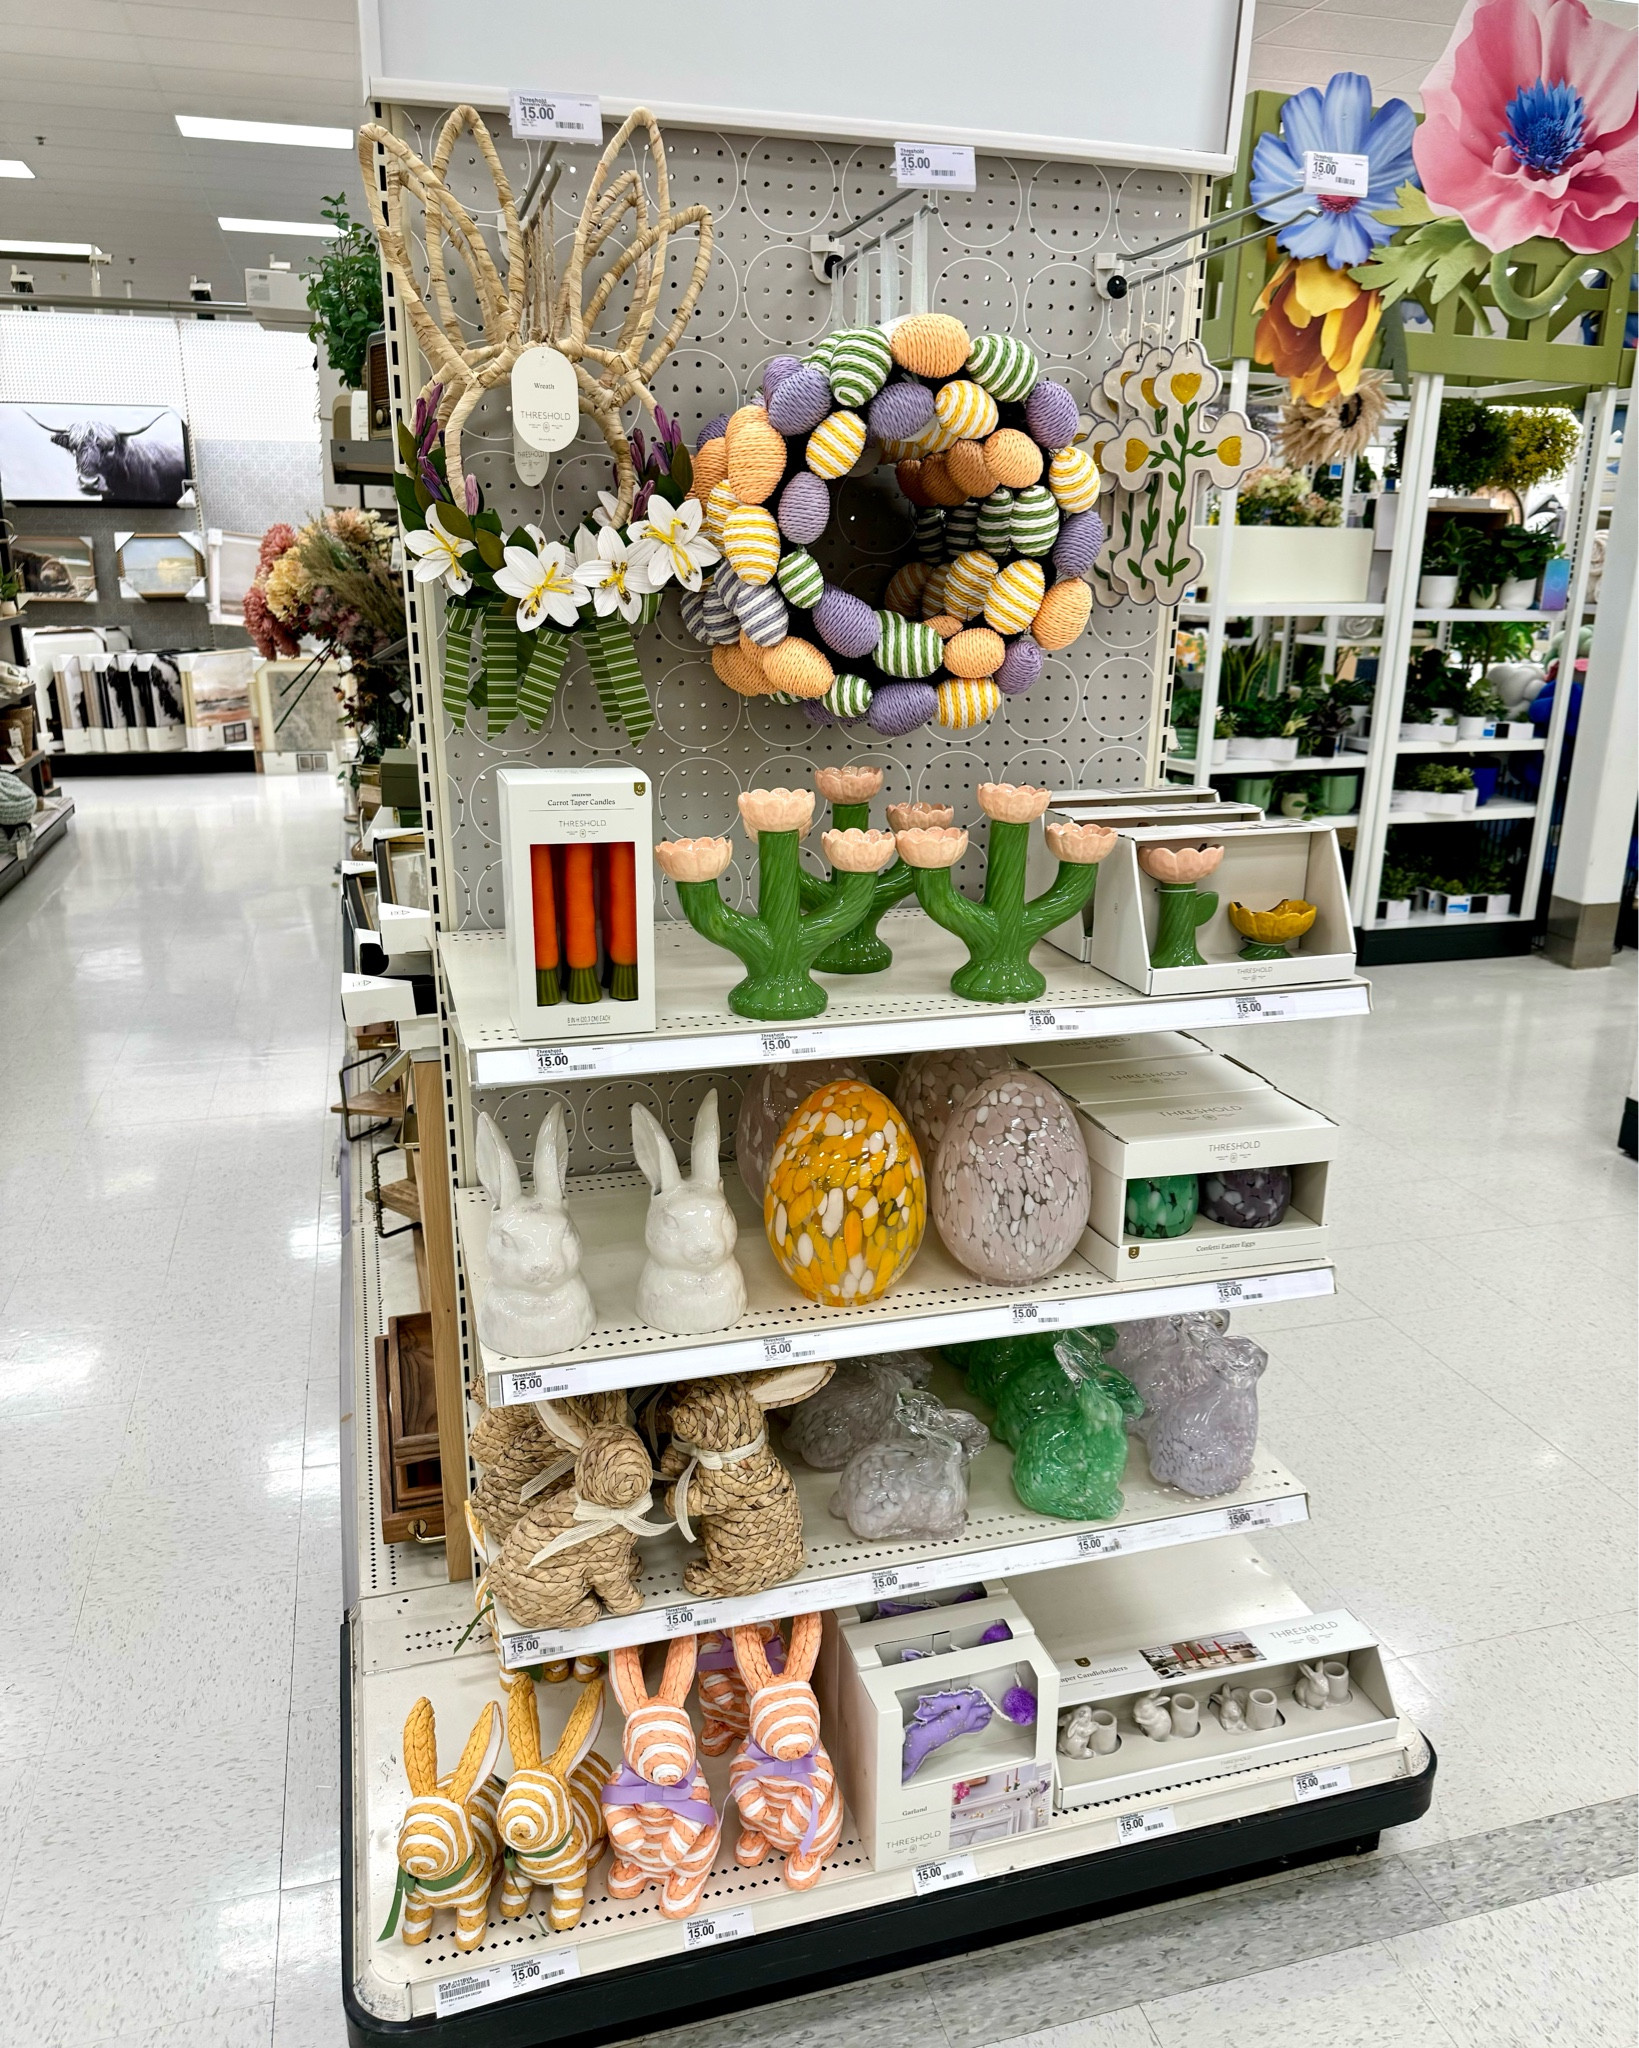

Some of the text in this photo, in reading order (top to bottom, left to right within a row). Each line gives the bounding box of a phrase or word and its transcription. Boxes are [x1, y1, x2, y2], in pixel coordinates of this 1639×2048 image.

[519, 96, 547, 104] Threshold
[521, 106, 554, 120] 15.00
[901, 157, 931, 169] 15.00
[1313, 162, 1337, 175] 15.00
[534, 382, 555, 390] Wreath
[520, 410, 571, 421] THRESHOLD
[517, 450, 545, 458] THRESHOLD
[1237, 966, 1273, 974] THRESHOLD
[1237, 1003, 1261, 1012] 15.00
[1029, 1016, 1056, 1025] 15.00
[762, 1040, 791, 1050] 15.00
[1058, 1037, 1131, 1047] THRESHOLD
[538, 1055, 568, 1066] 15.00
[1108, 1070, 1188, 1081] THRESHOLD
[1157, 1105, 1242, 1117] THRESHOLD
[1209, 1140, 1261, 1152] THRESHOLD
[1218, 1287, 1242, 1297] 15.00
[1013, 1309, 1037, 1318] 15.00
[764, 1343, 791, 1355] 15.00
[513, 1378, 542, 1391] 15.00
[1228, 1513, 1251, 1524] 15.00
[1078, 1539, 1101, 1550] 15.00
[873, 1576, 897, 1588] 15.00
[667, 1612, 693, 1625] 15.00
[1269, 1621, 1338, 1639] THRESHOLD
[511, 1640, 539, 1653] 15.00
[1077, 1666, 1128, 1679] Candleholders
[1297, 1777, 1318, 1789] 15.00
[902, 1806, 927, 1816] Garland
[1121, 1818, 1143, 1830] 15.00
[886, 1830, 941, 1848] THRESHOLD
[917, 1867, 941, 1880] 15.00
[688, 1925, 714, 1939] 15.00
[511, 1960, 534, 1969] Threshold
[512, 1965, 540, 1981] 15.00
